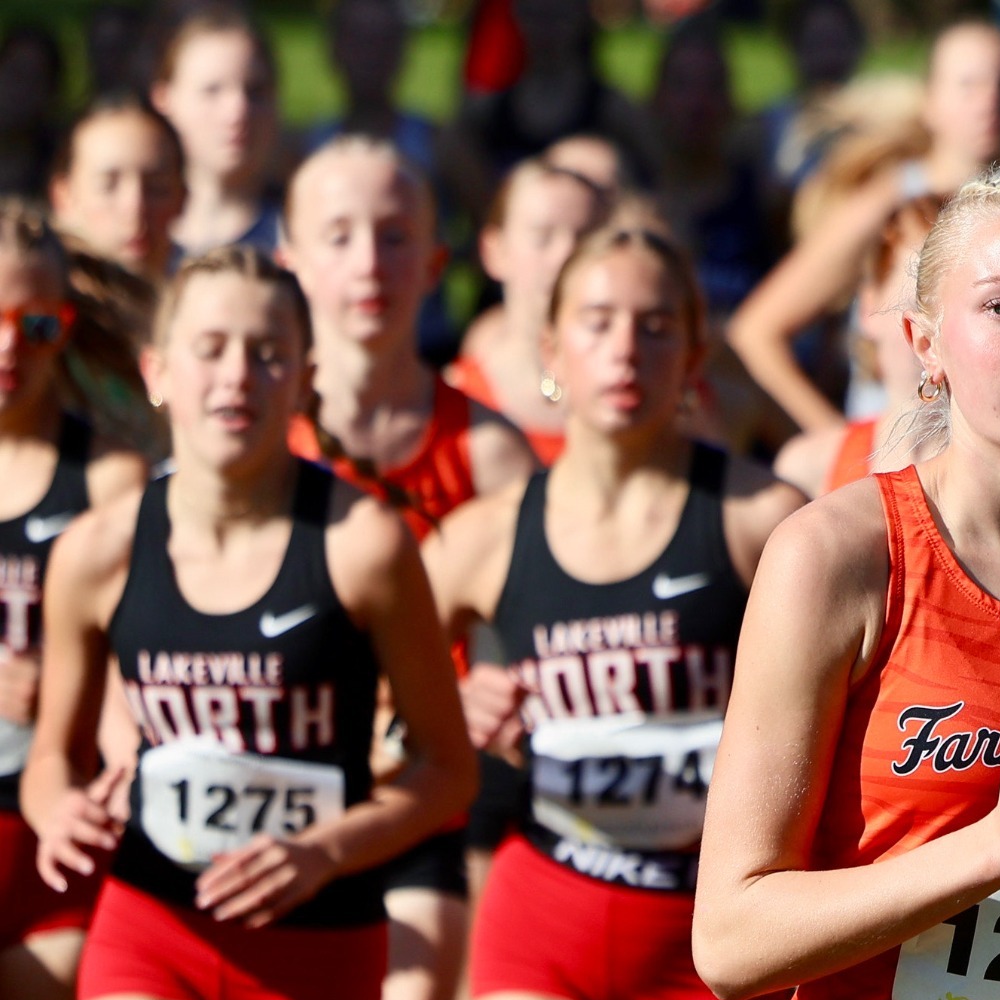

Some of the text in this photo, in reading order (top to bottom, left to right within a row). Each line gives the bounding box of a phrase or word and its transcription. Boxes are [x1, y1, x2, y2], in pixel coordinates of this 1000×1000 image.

[532, 609, 680, 658] LAKEVILLE
[137, 650, 284, 686] LAKEVILLE
[566, 750, 709, 806] 1274
[170, 779, 316, 834] 1275
[554, 836, 680, 889] NIKE
